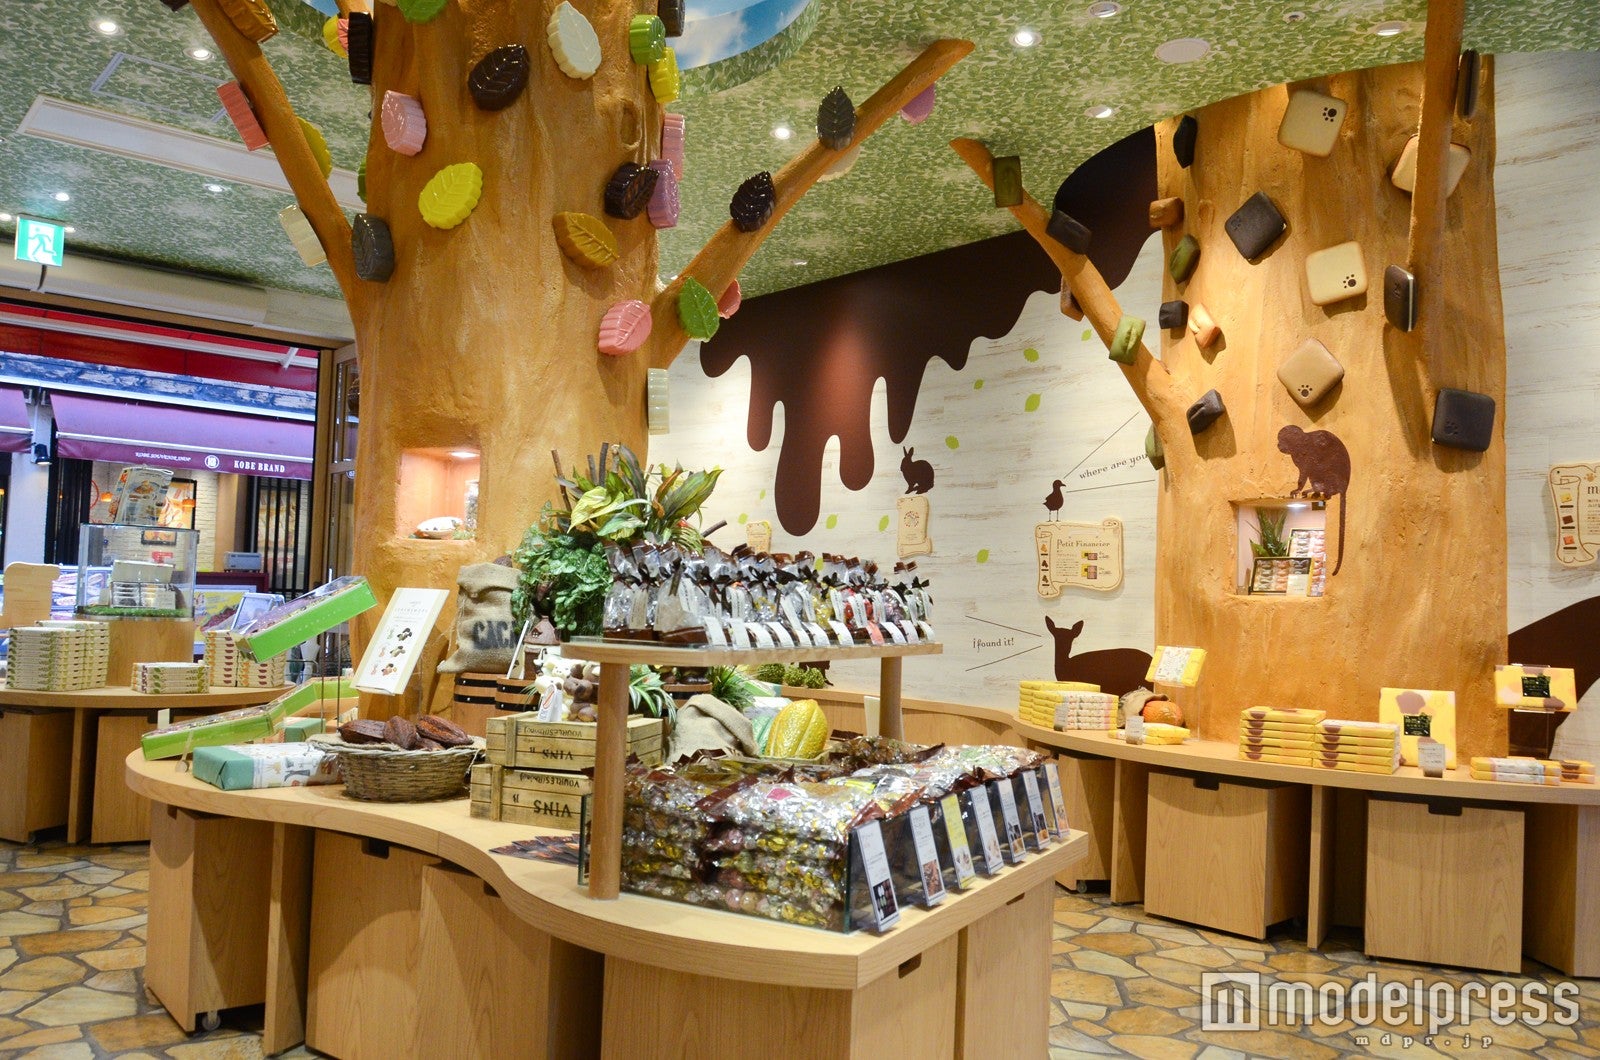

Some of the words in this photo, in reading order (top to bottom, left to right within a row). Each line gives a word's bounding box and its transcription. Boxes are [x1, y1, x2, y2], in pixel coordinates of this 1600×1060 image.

[234, 460, 256, 470] KOBE
[258, 463, 286, 473] BRAND
[1079, 466, 1108, 479] where
[1110, 460, 1127, 470] are
[1056, 539, 1074, 549] Petit
[1075, 540, 1111, 548] Financier
[977, 638, 1002, 653] found
[1004, 637, 1014, 646] it!
[542, 748, 574, 761] VINS
[533, 799, 573, 818] VINS
